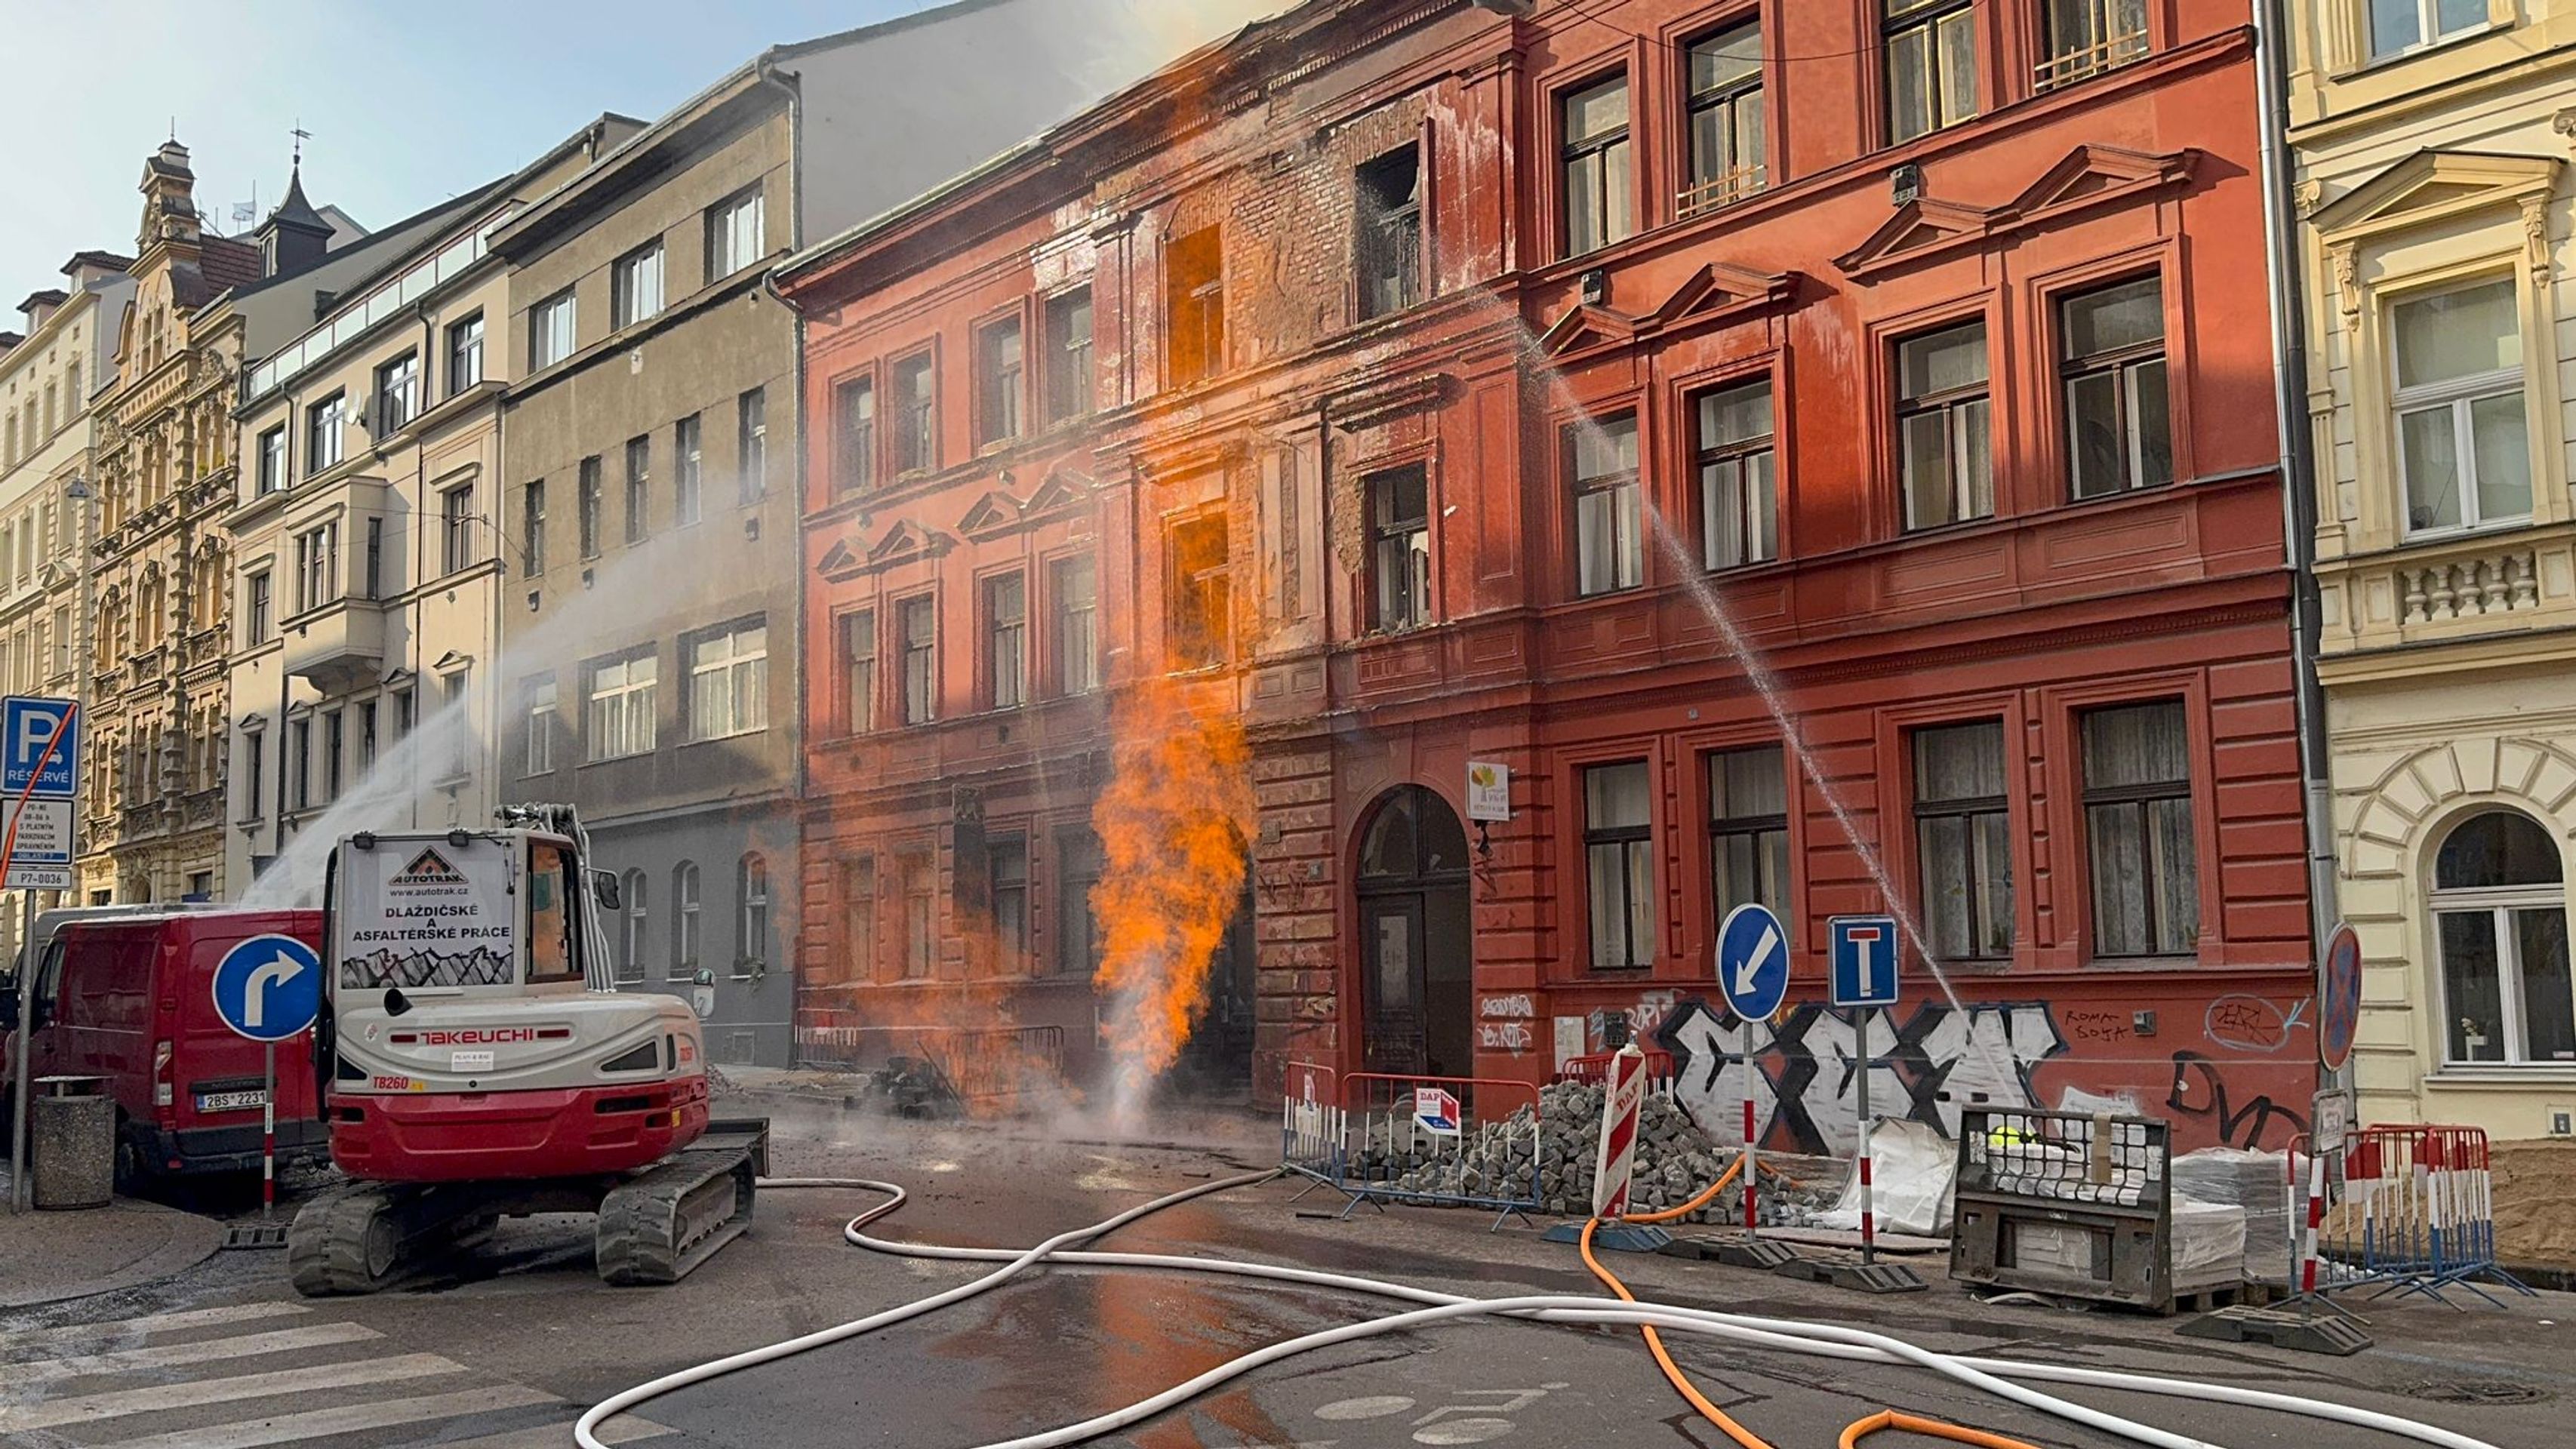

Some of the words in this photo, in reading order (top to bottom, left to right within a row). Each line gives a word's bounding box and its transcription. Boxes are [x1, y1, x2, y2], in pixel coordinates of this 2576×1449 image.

[20, 872, 62, 884] P7-0036
[392, 875, 466, 884] AUTOTRAK
[389, 887, 469, 897] www.autotrak.cz
[386, 903, 479, 918] DLAŽDIČSKÉ
[426, 918, 436, 928] A
[352, 927, 457, 942] ASFALTÉRSKÉ
[461, 925, 510, 938] PRÁCE
[420, 1028, 534, 1045] TAKEUCHI
[373, 1076, 409, 1089] TB260
[208, 1095, 229, 1108] 2BS
[238, 1092, 266, 1104] 2231
[1420, 1092, 1440, 1101] DAP
[1617, 1082, 1638, 1112] DAP
